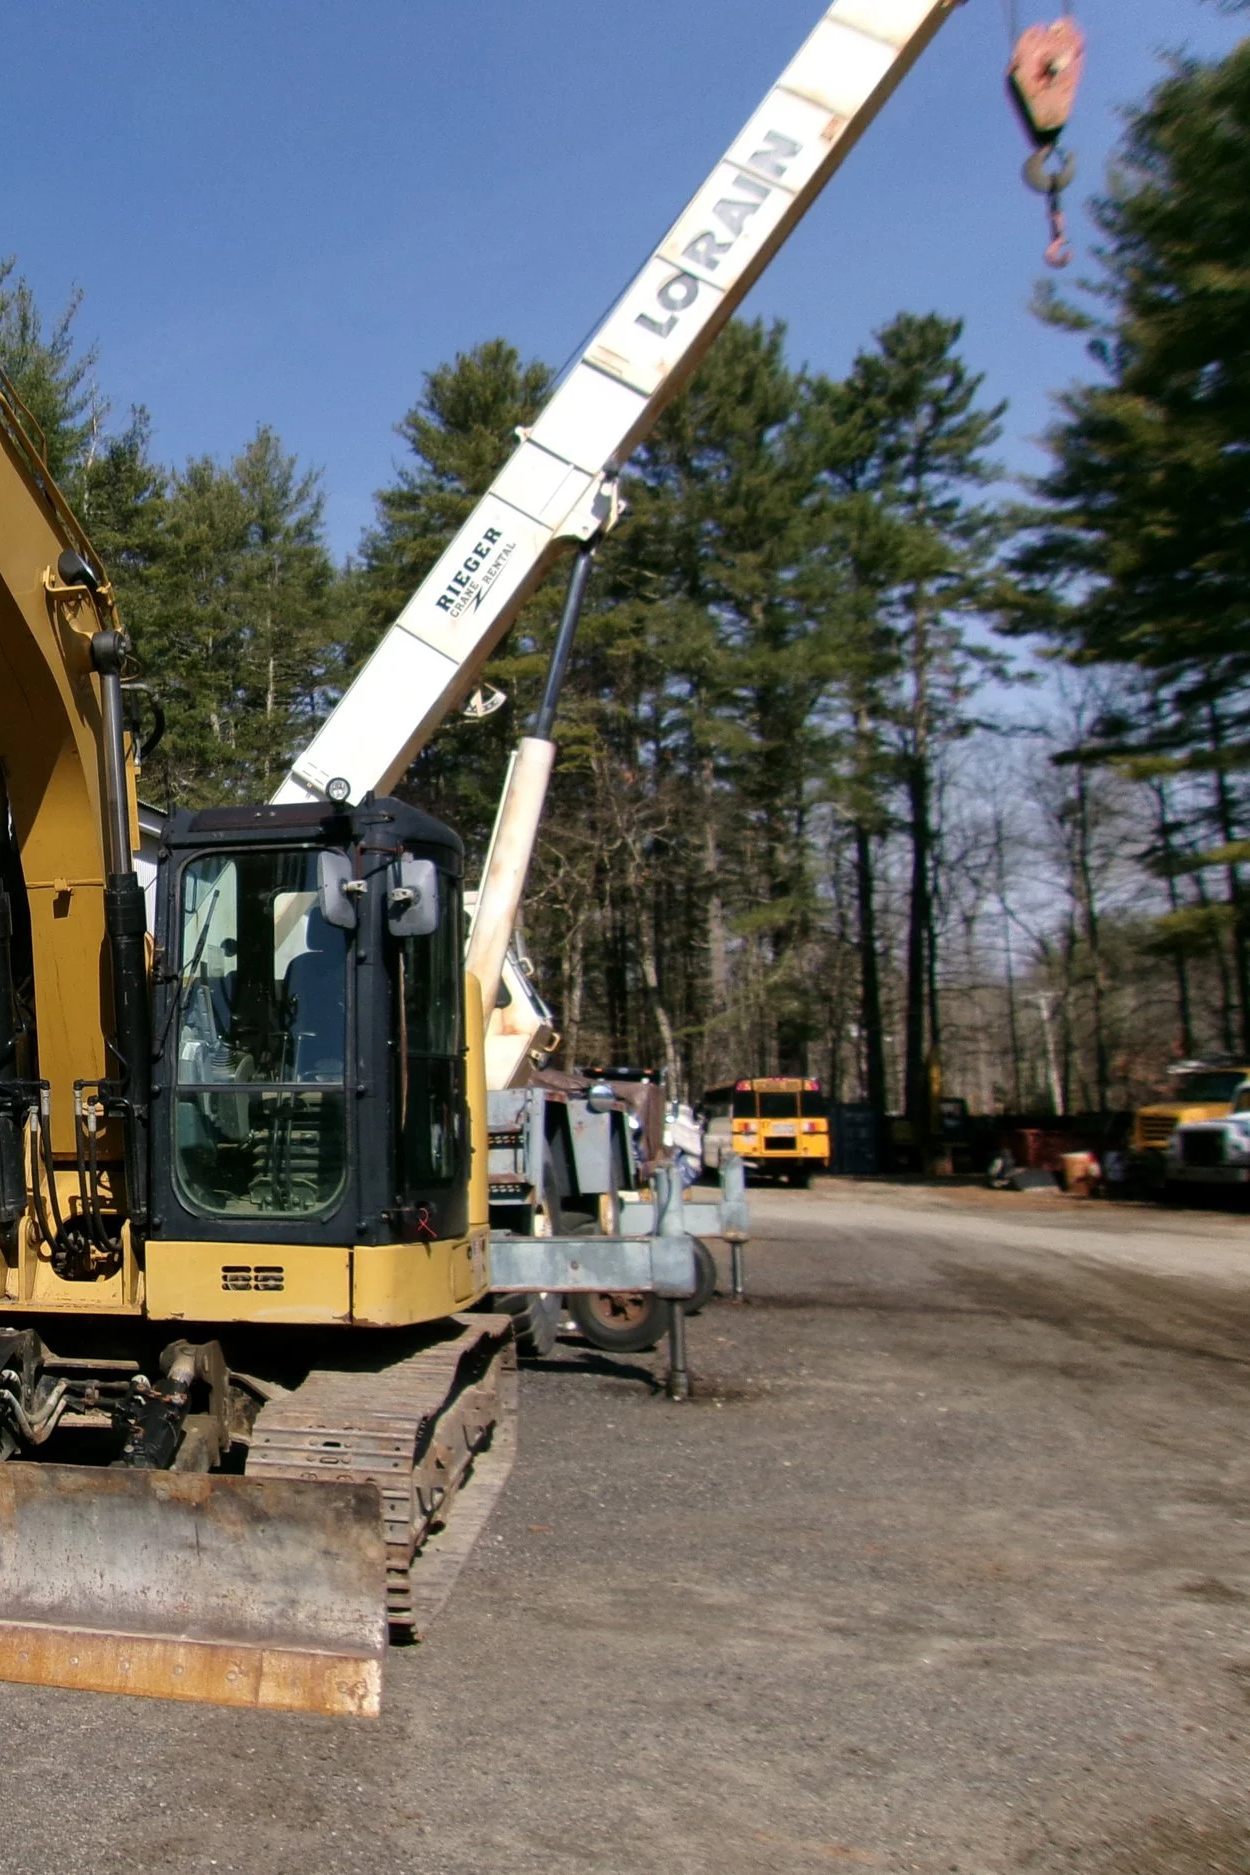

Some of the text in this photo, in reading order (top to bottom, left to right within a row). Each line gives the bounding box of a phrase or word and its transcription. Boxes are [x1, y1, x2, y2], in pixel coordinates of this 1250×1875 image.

[634, 129, 803, 340] LORAIN
[435, 526, 503, 613] RIEGER
[449, 541, 517, 619] CRANE RENTAL
